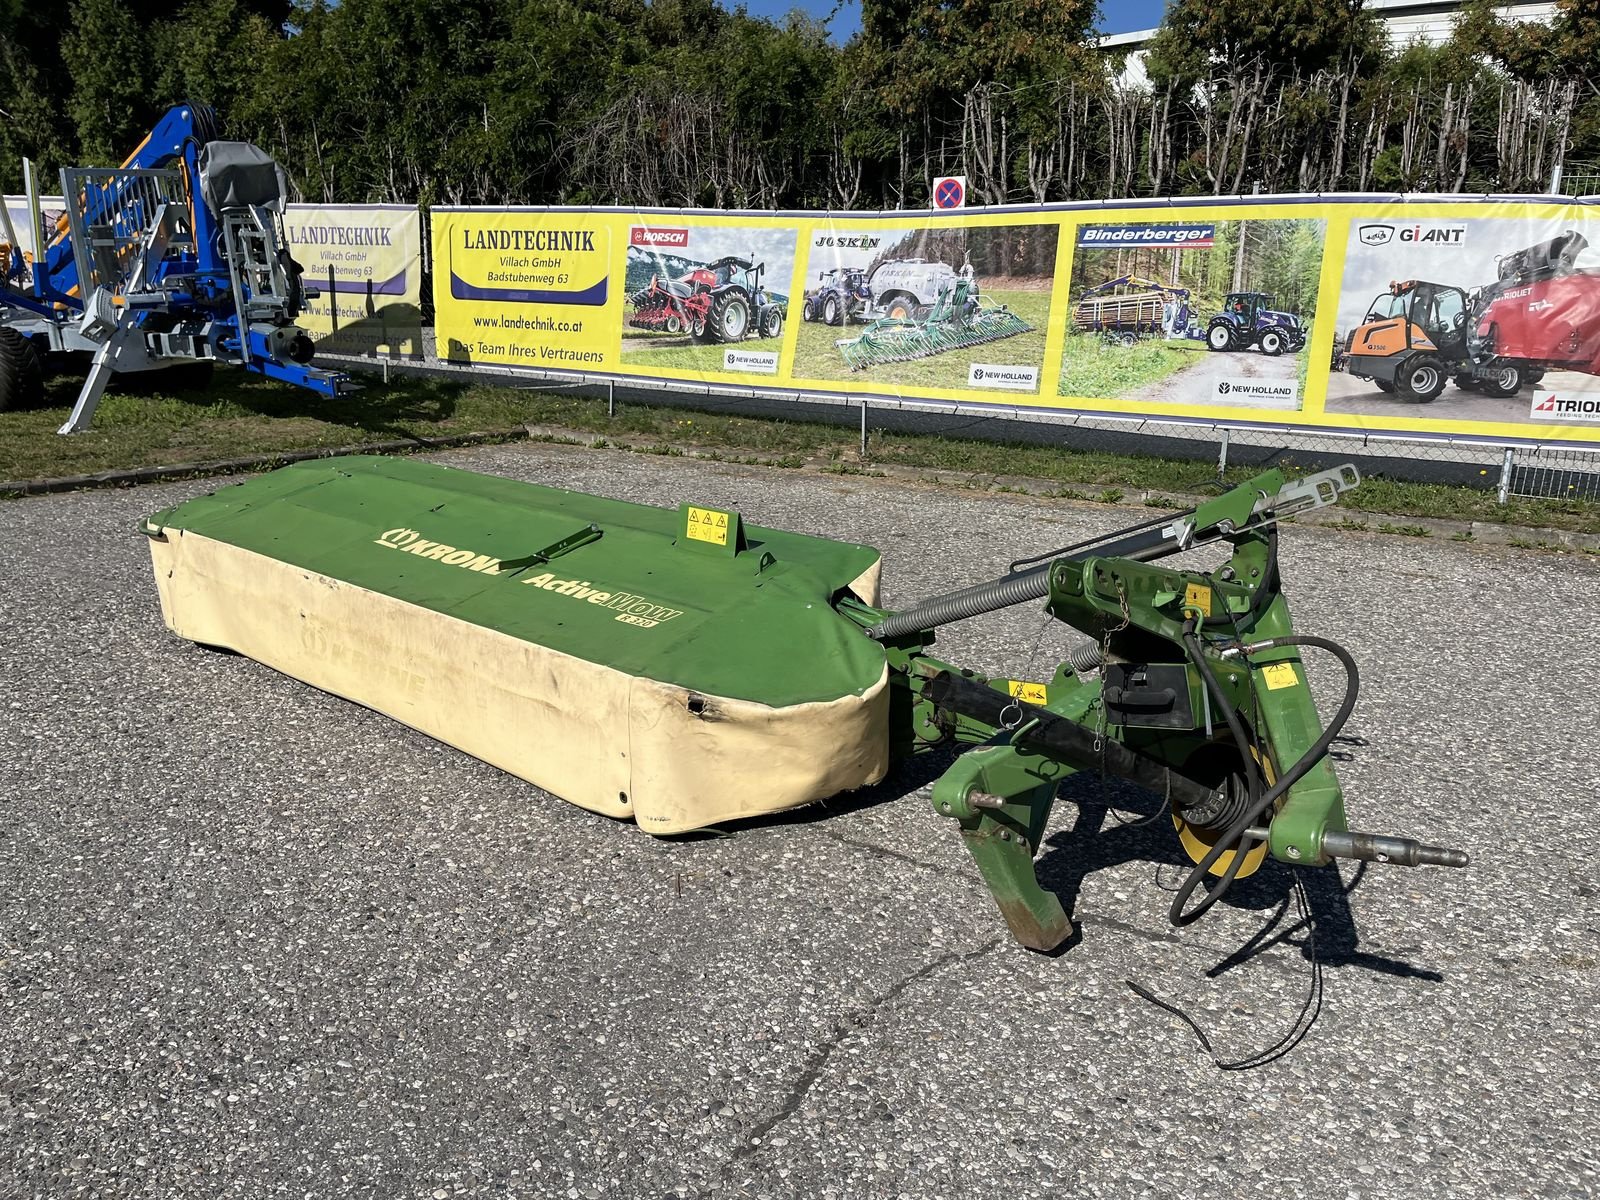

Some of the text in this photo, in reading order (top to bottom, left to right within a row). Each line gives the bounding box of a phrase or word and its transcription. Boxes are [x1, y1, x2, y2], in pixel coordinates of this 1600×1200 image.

[289, 226, 392, 246] LANDTECHNIK
[464, 230, 595, 251] LANDTECHNIK
[643, 232, 685, 243] HORSCH
[1083, 229, 1211, 241] Binderberger
[815, 236, 881, 249] JOSKIN
[320, 251, 367, 261] Villach GmbH
[499, 256, 562, 268] Villach GmbH
[311, 264, 373, 277] Badsbenweg 63
[487, 271, 569, 286] Badstubenweg 63
[473, 314, 583, 332] www.landtechnik.co.at
[455, 341, 604, 363] Das Team Ihres Vertrauens
[985, 371, 1033, 381] NEW HOLLAND
[1232, 385, 1292, 395] NEW HOLLAND
[521, 573, 685, 622] ActiveMow
